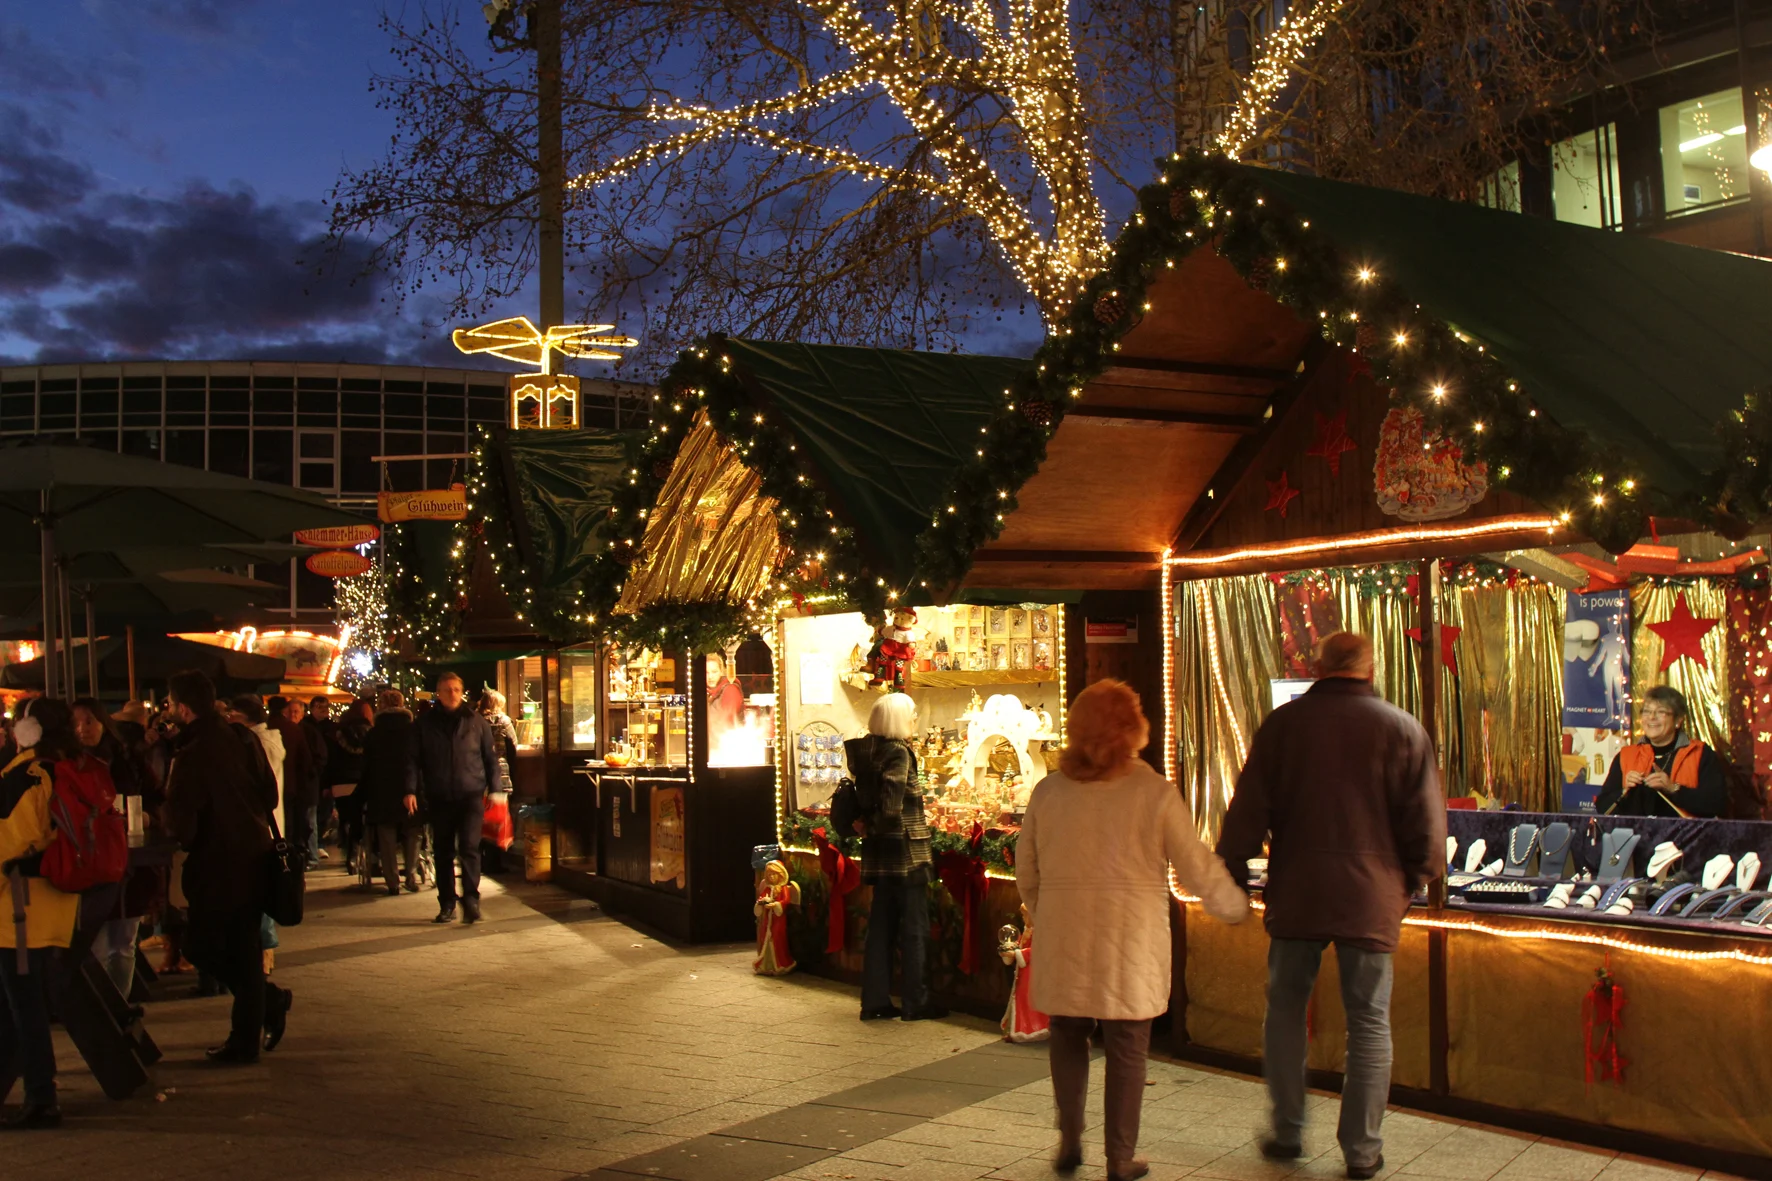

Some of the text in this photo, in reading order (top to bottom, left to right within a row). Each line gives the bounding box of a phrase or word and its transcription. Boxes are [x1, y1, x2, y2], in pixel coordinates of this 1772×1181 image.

[408, 500, 464, 514] Glühwein
[311, 555, 367, 571] Kartoffelpuffer
[1580, 598, 1588, 608] is
